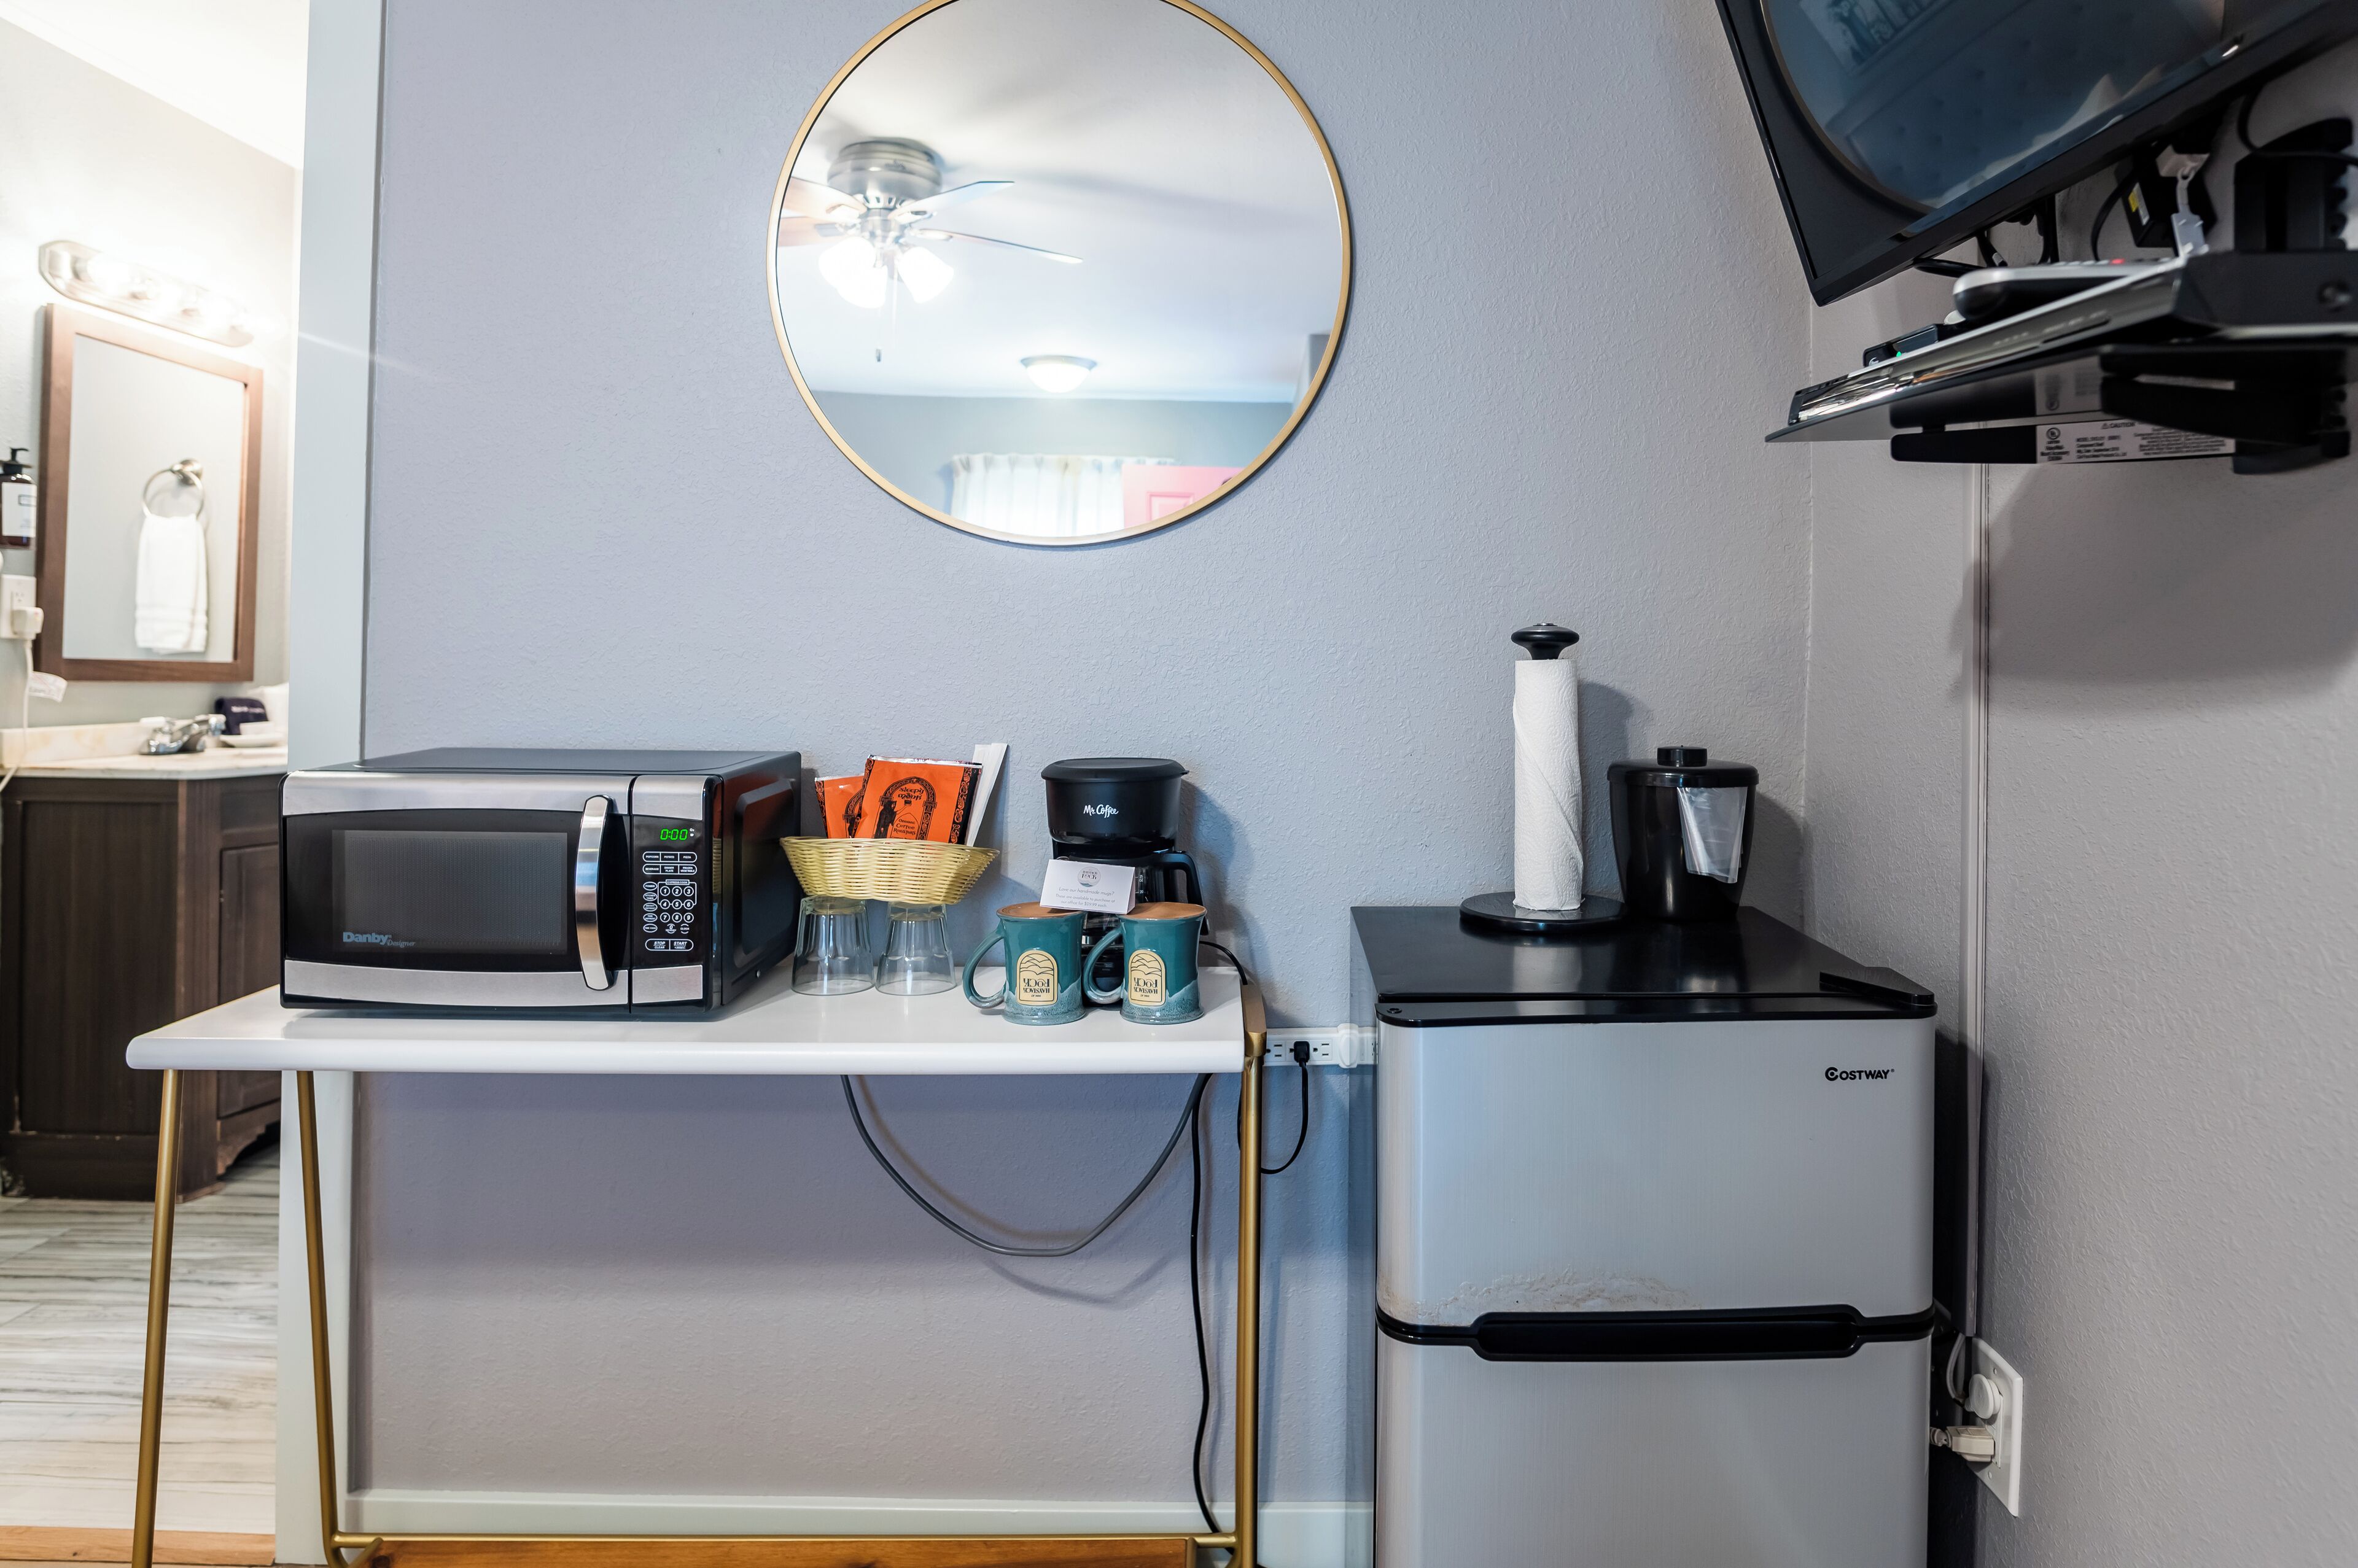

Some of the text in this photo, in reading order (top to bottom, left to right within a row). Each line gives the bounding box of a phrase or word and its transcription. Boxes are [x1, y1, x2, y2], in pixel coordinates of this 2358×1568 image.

[1083, 804, 1119, 818] Mr. Coffee
[660, 829, 688, 840] 0:00
[343, 931, 416, 948] Danby Designer
[1023, 978, 1050, 988] ROCK
[1134, 977, 1158, 988] ROCK
[1824, 1066, 1890, 1082] COSTWAY
